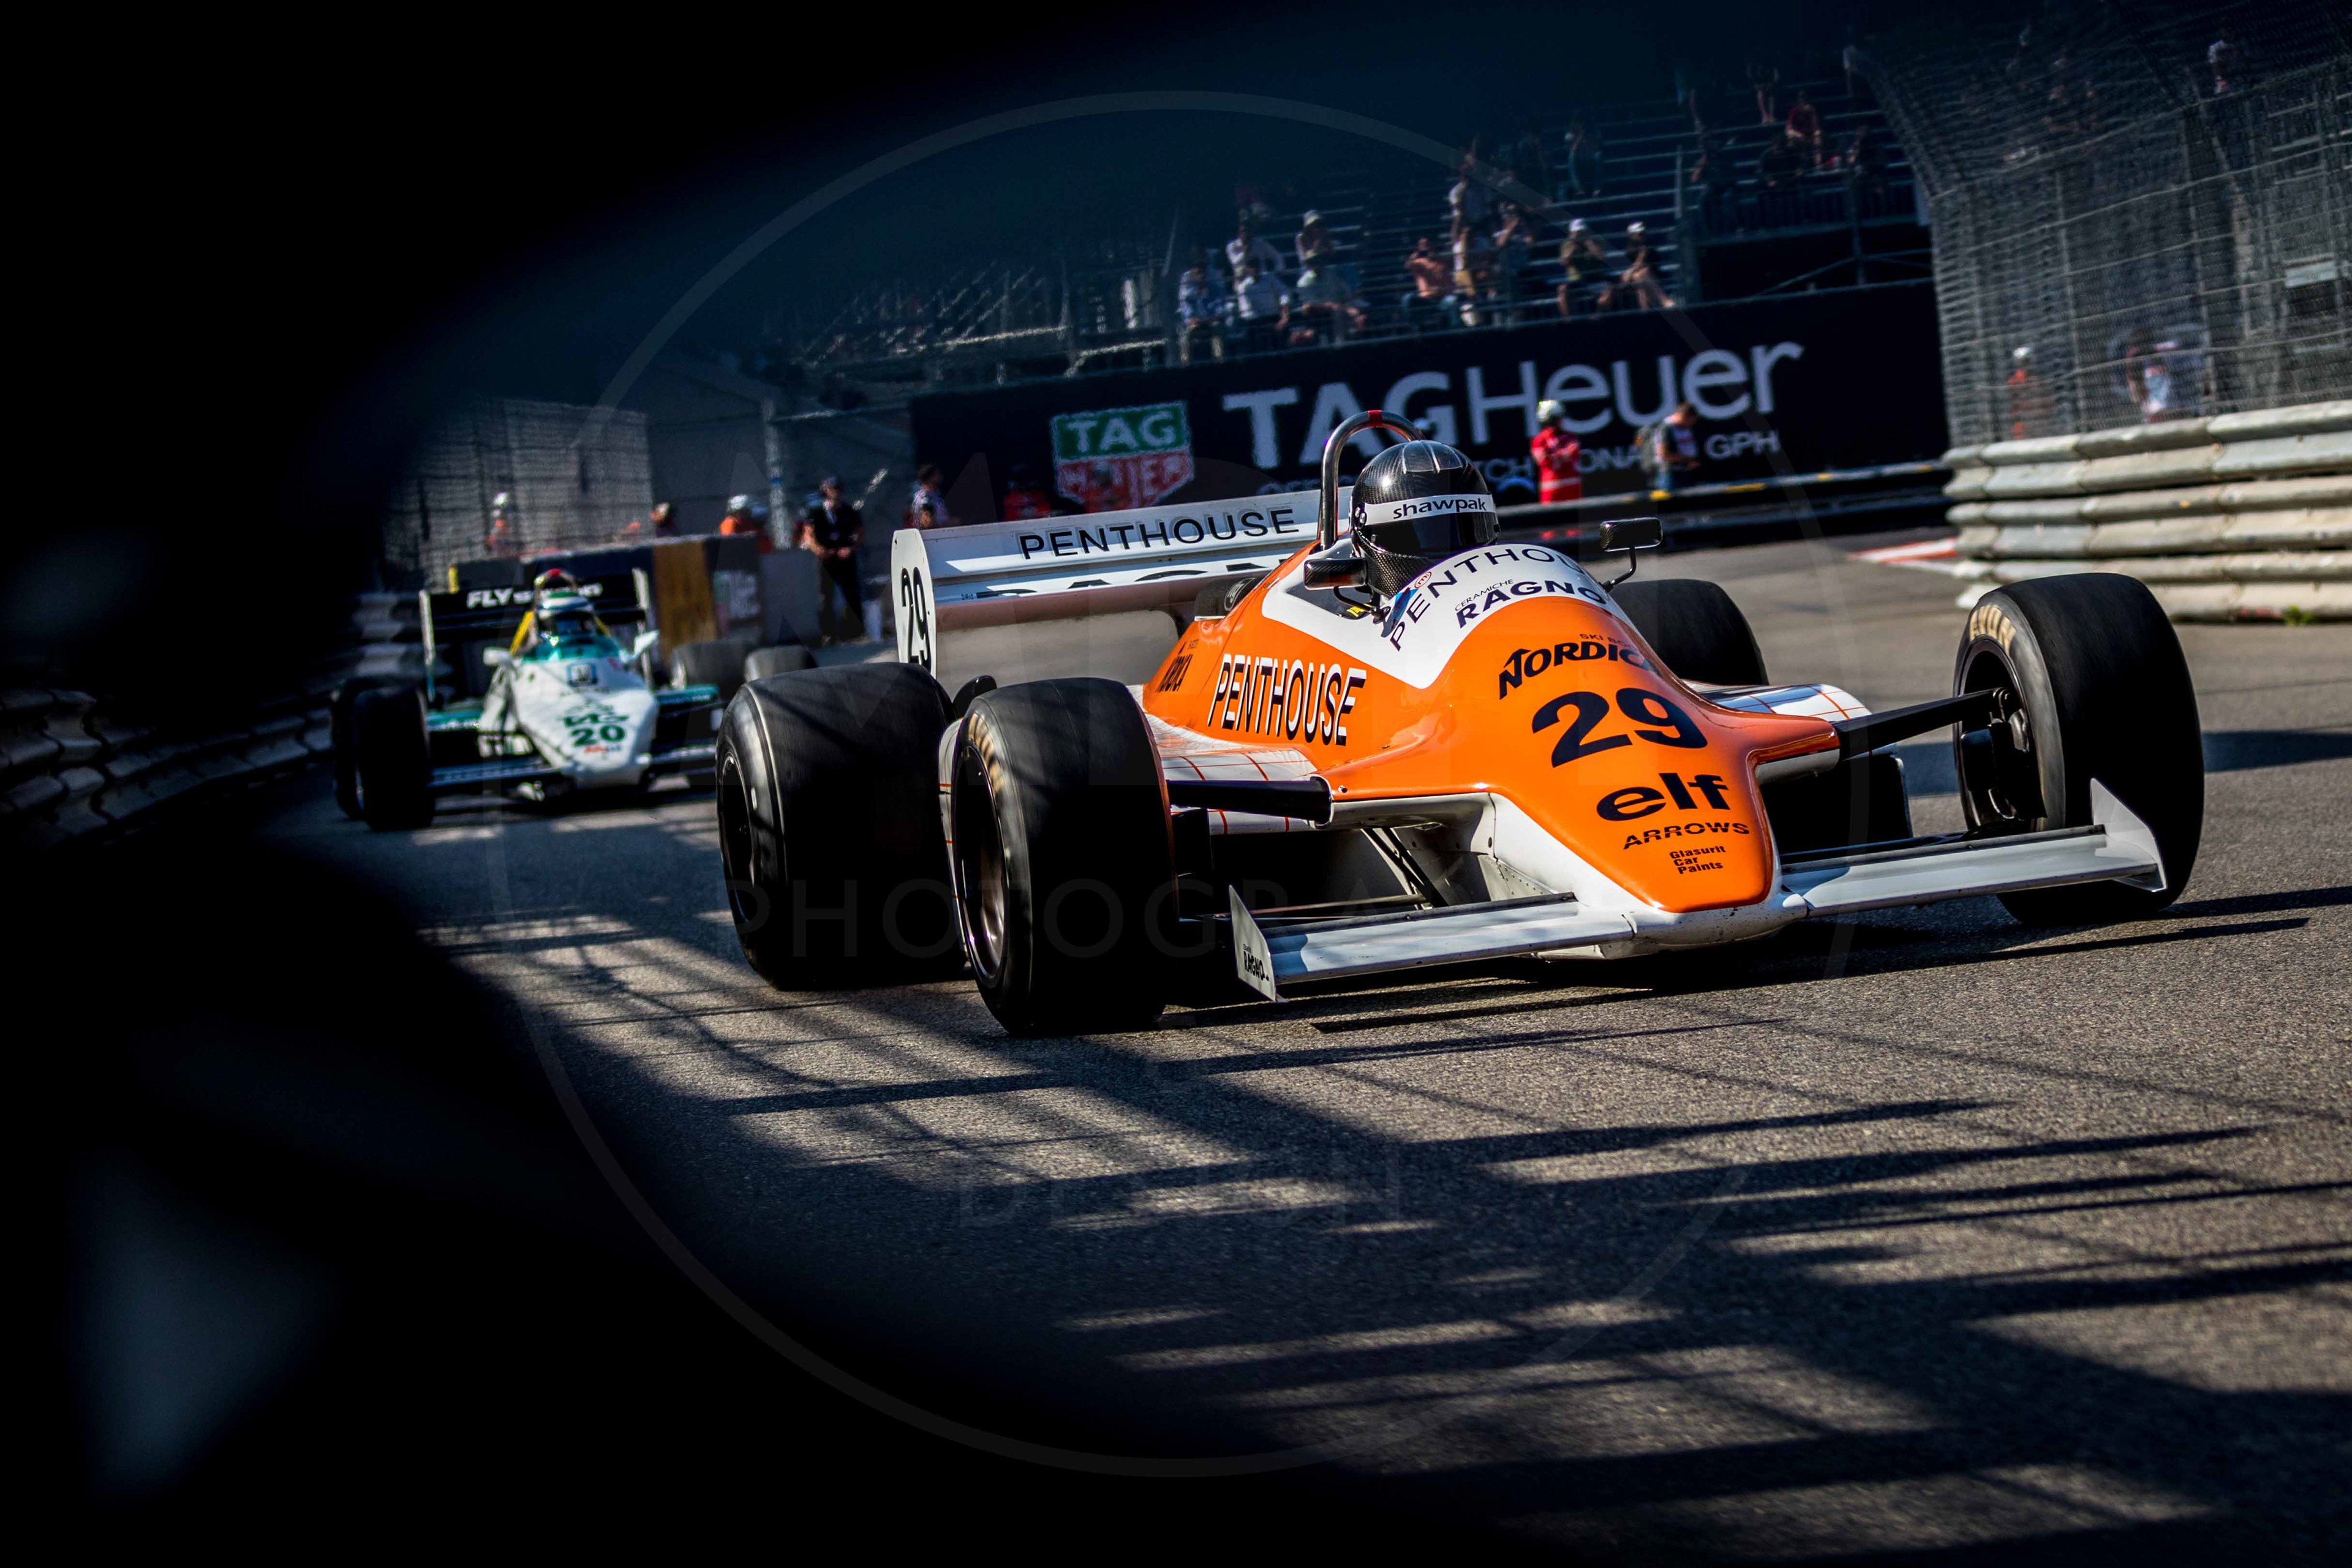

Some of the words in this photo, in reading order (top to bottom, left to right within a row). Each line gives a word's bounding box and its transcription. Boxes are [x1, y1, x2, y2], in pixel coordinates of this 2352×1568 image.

[1066, 410, 1177, 453] TAG
[1703, 431, 1778, 461] GPH
[1392, 497, 1488, 520] shawpak
[1019, 508, 1300, 560] PENTHOUSE
[1454, 578, 1514, 612] CERAMICHE
[1455, 580, 1607, 629] RAGNO
[900, 566, 932, 670] 29
[1207, 653, 1367, 747] PENTHOUSE
[570, 725, 625, 747] 20
[1531, 687, 1709, 769] 29
[1596, 772, 1731, 822] elf
[1623, 822, 1750, 850] ARROWS
[1668, 845, 1727, 859] Glasurit
[1673, 856, 1699, 867] Car
[1676, 861, 1724, 875] Paints
[1243, 951, 1265, 981] RAGNO
